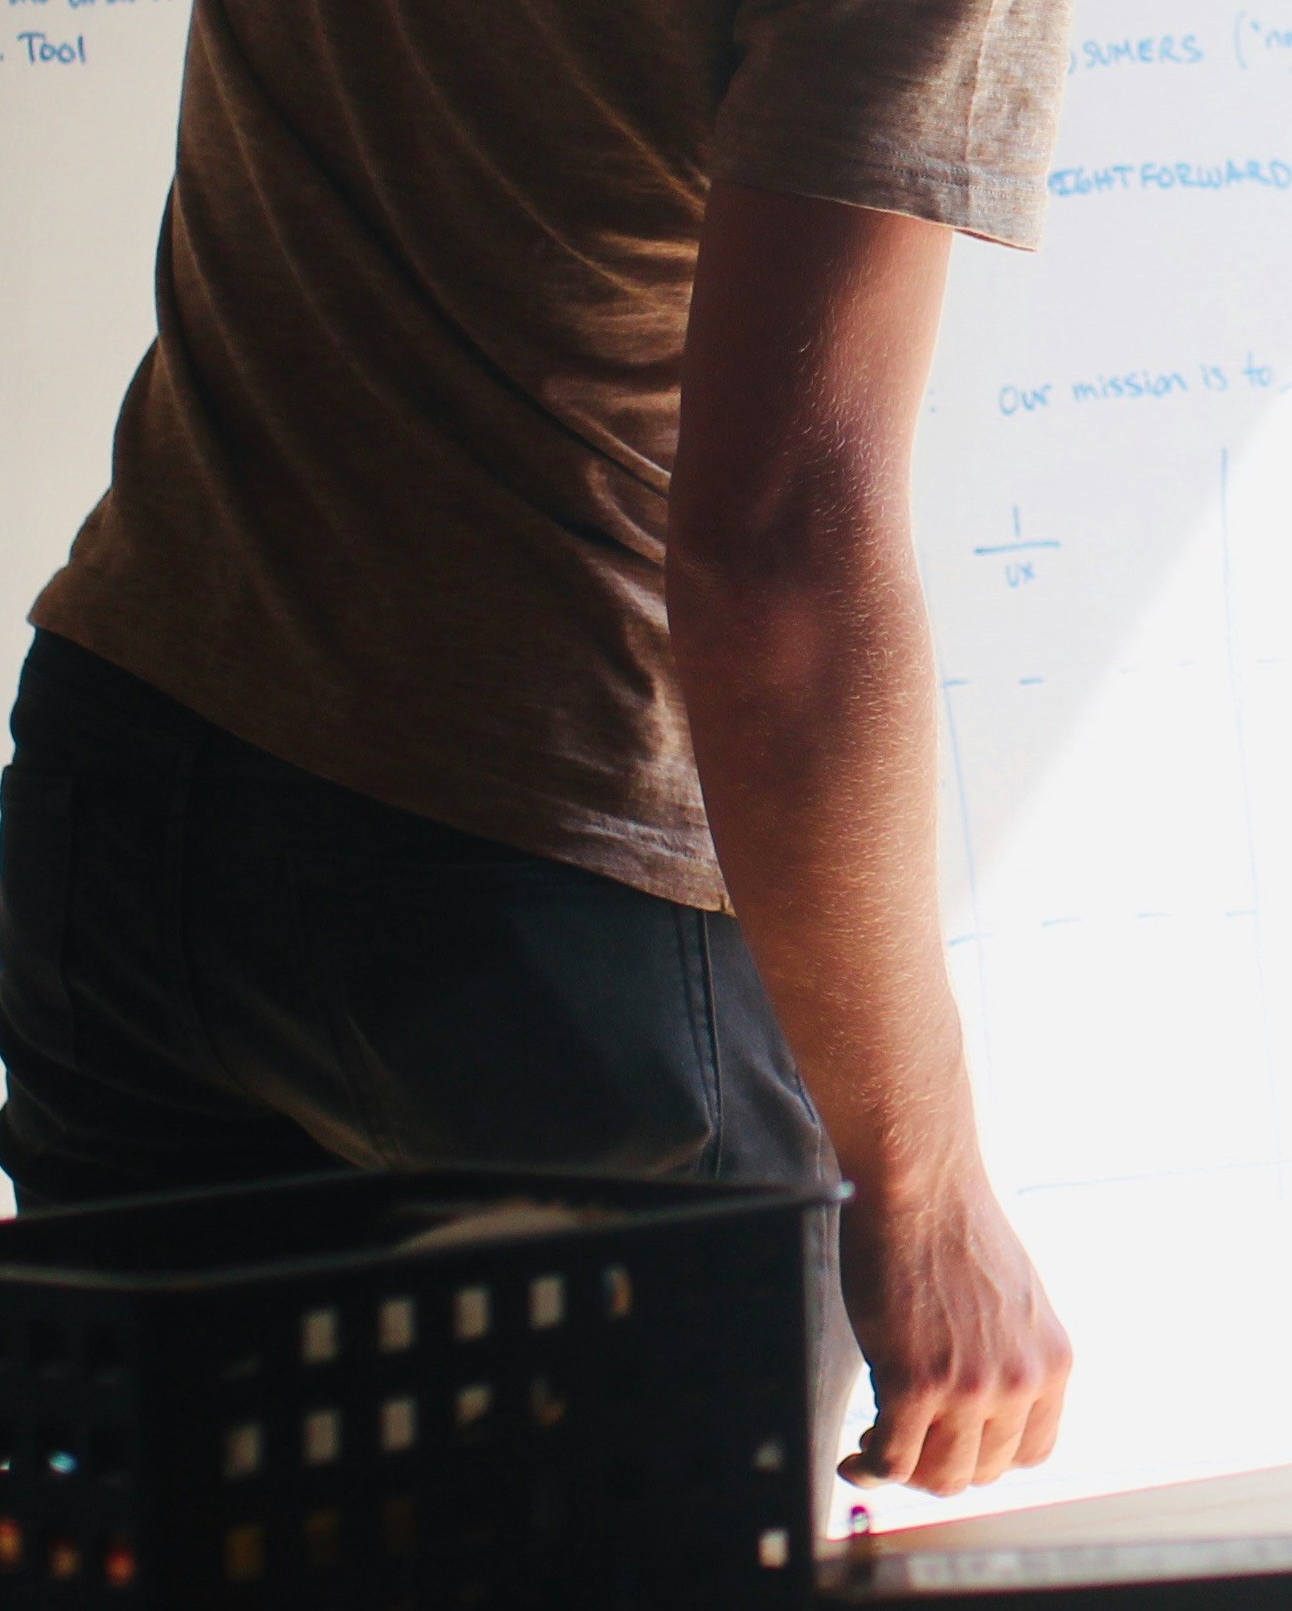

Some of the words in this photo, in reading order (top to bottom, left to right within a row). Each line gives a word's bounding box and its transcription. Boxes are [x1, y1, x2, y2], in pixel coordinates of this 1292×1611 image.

[16, 30, 86, 65] Tool
[999, 382, 1054, 417] Our
[1071, 368, 1190, 402] mission
[1200, 360, 1229, 391] is
[1241, 349, 1274, 389] to
